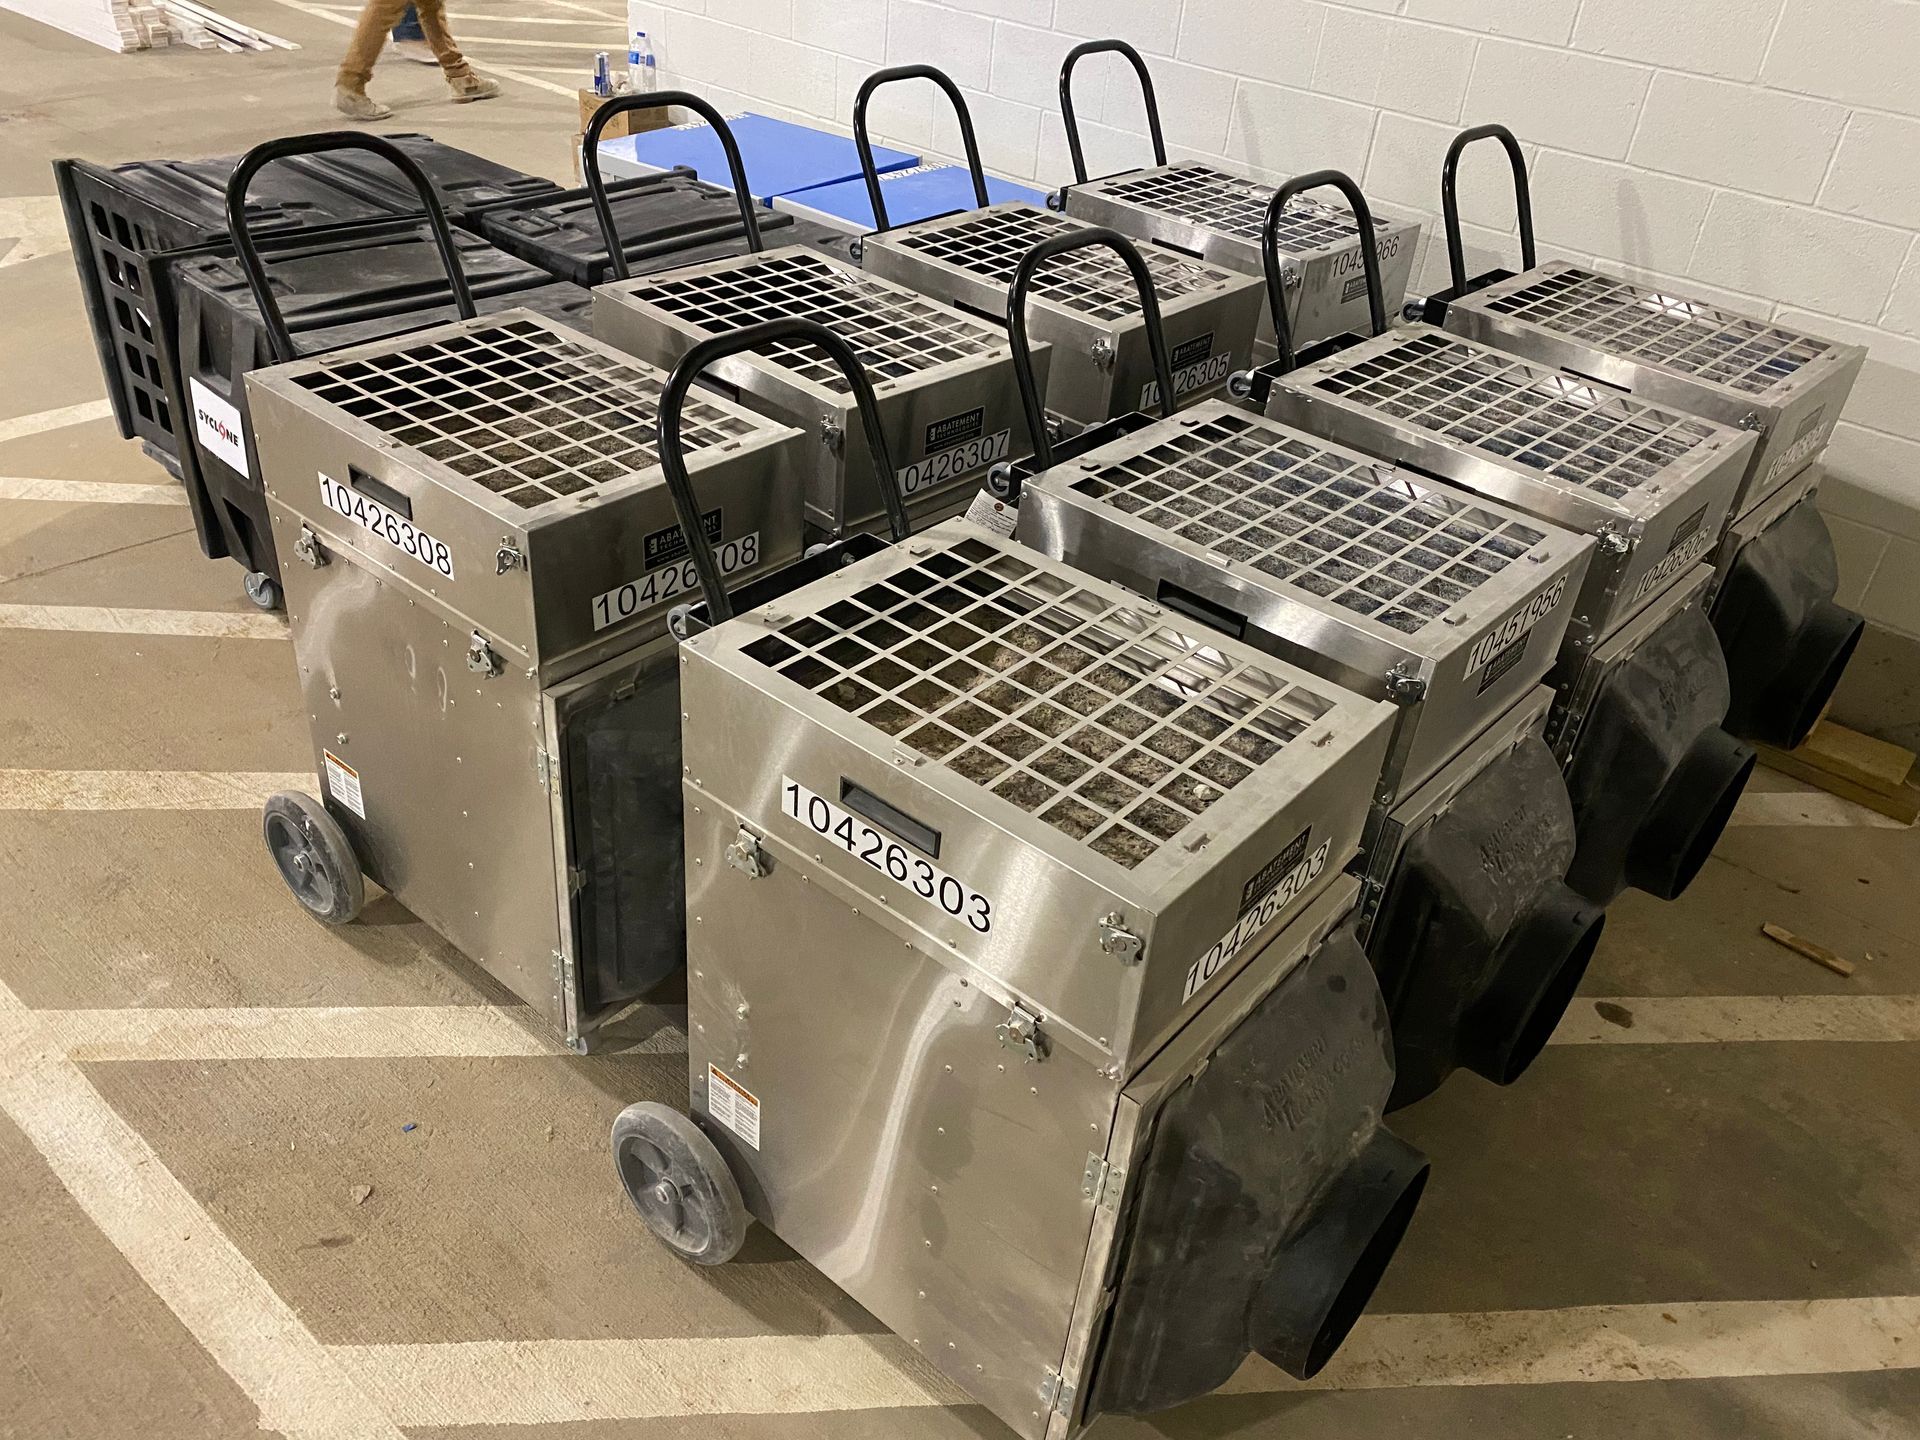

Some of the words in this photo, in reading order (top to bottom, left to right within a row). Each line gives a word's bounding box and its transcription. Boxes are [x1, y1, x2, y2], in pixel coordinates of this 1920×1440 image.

[937, 412, 980, 434] ABATEMENT
[1143, 353, 1229, 407] 1026305
[198, 408, 240, 448] SYCLONE
[896, 430, 1009, 493] 0426307
[322, 477, 452, 576] 10426308
[597, 535, 757, 625] 1042608
[1469, 576, 1566, 674] 10451956
[786, 783, 992, 934] 10426303
[1187, 842, 1328, 996] 10426303
